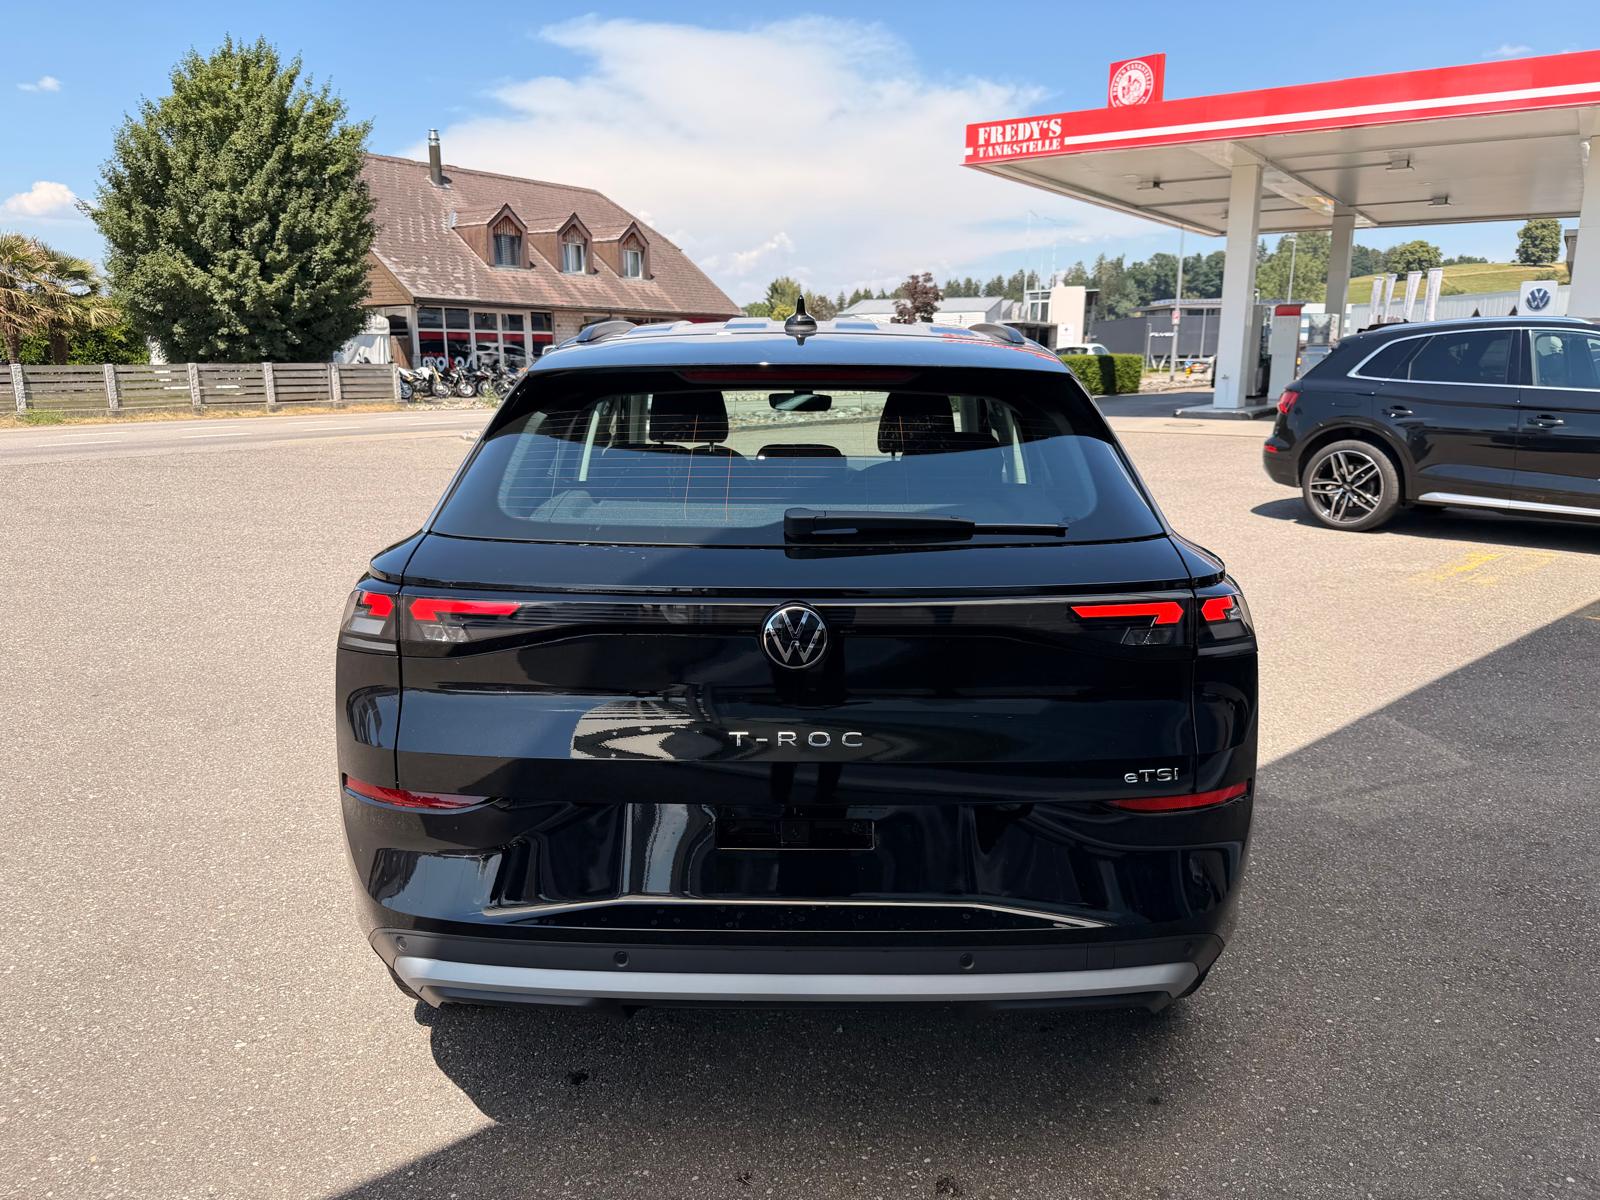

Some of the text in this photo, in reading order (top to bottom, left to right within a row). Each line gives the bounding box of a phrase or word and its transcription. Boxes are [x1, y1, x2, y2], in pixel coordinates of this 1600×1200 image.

[978, 119, 1062, 145] FREDY'S
[977, 138, 1061, 158] TANKSTELLE
[728, 731, 863, 747] T-ROC
